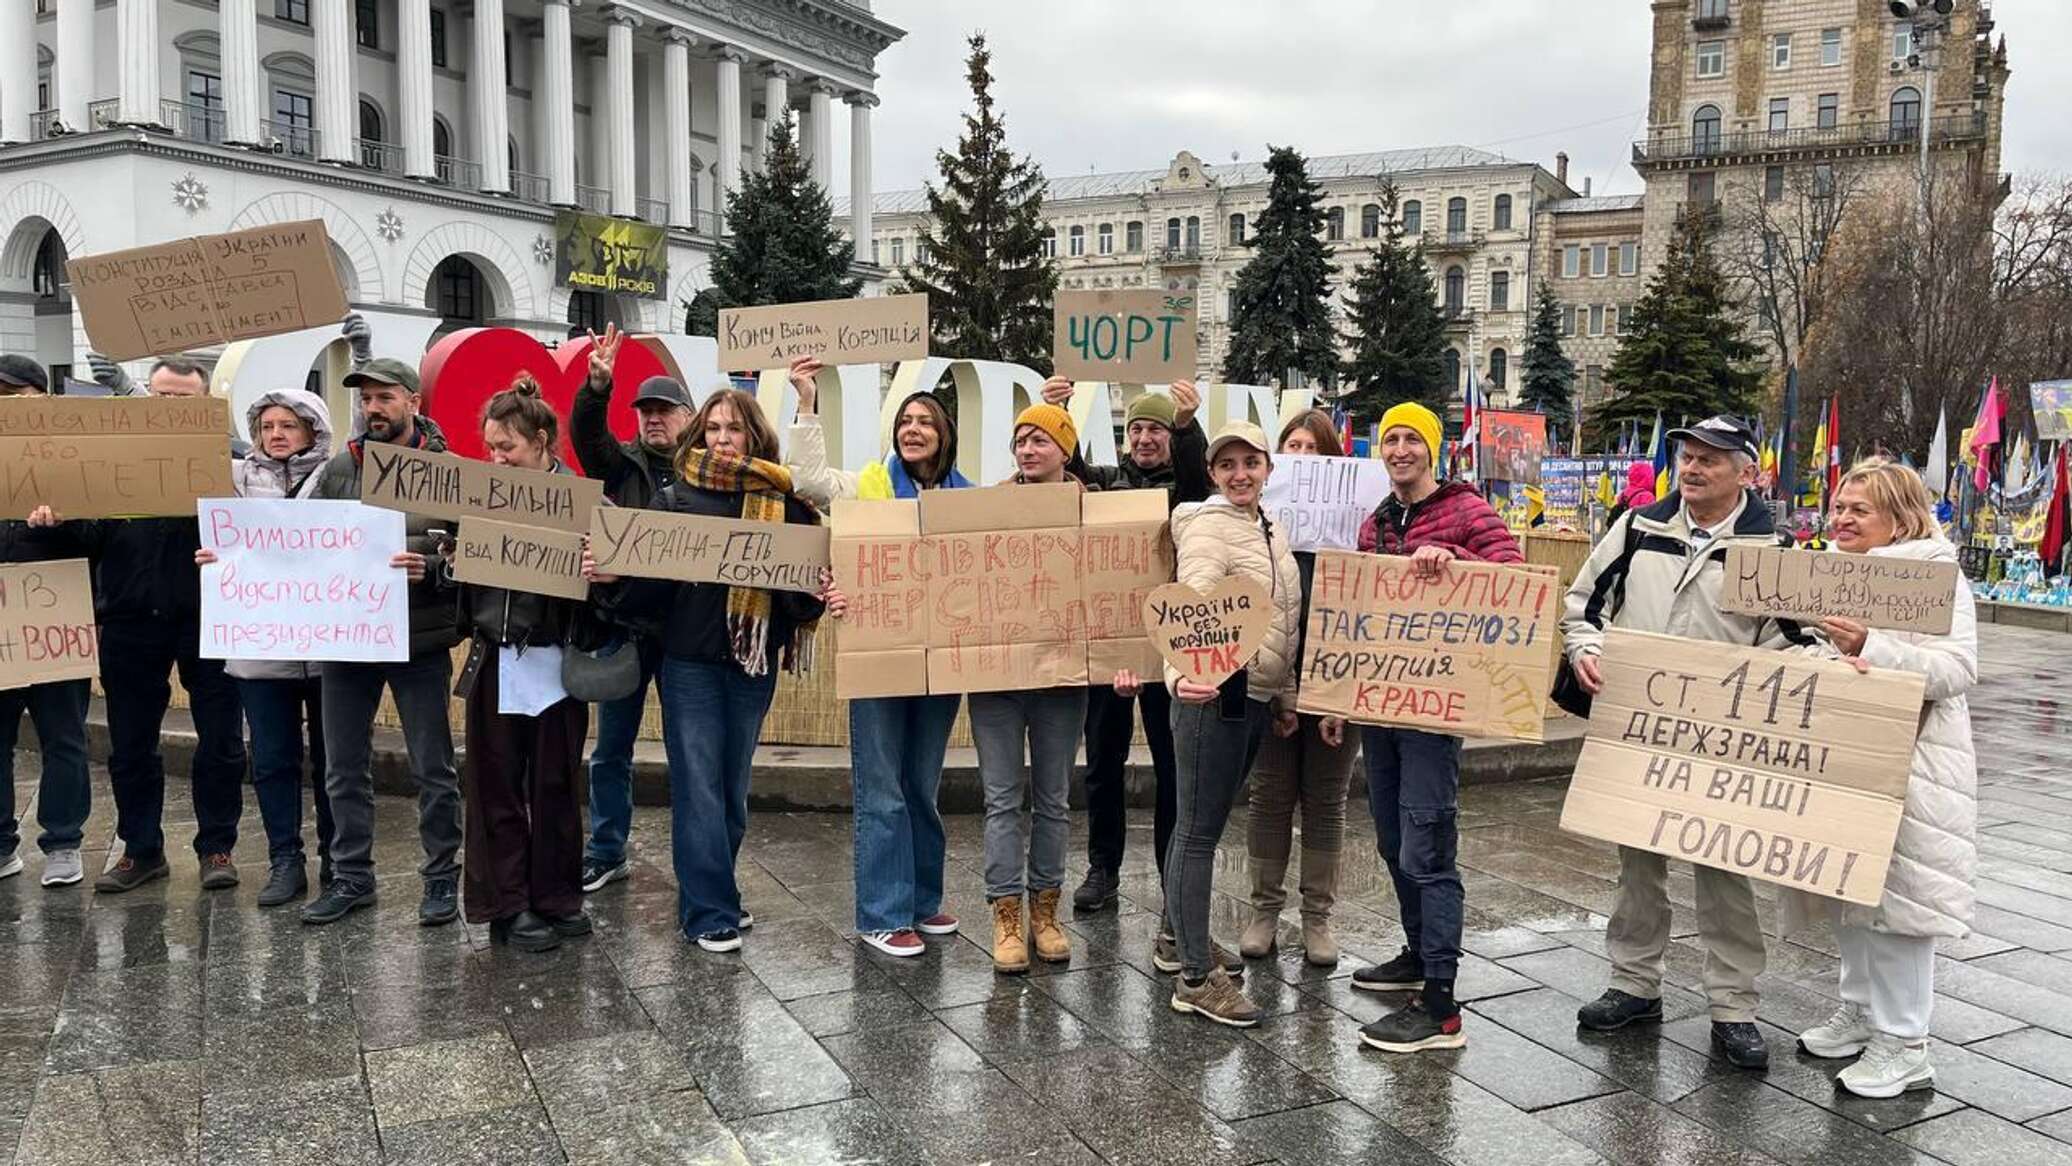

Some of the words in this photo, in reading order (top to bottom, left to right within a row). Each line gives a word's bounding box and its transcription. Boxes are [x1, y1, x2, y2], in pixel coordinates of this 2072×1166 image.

[77, 250, 204, 286] КОНСТИТУЦІЯ
[251, 252, 270, 271] 5
[1070, 315, 1185, 361] ЧОРТ
[100, 409, 131, 429] НА
[80, 457, 217, 501] ГЕТЬ
[487, 477, 573, 520] ВІЛЬНА
[220, 560, 391, 613] відставку
[1321, 559, 1361, 600] НІ
[213, 622, 397, 654] президента
[1315, 607, 1375, 641] ТАК
[1385, 610, 1540, 646] ПЕРЕМОЗІ
[1183, 644, 1241, 675] ТАК
[1354, 682, 1465, 722] КРАДЕ
[1720, 660, 1820, 729] 111
[1644, 756, 1693, 791] НА
